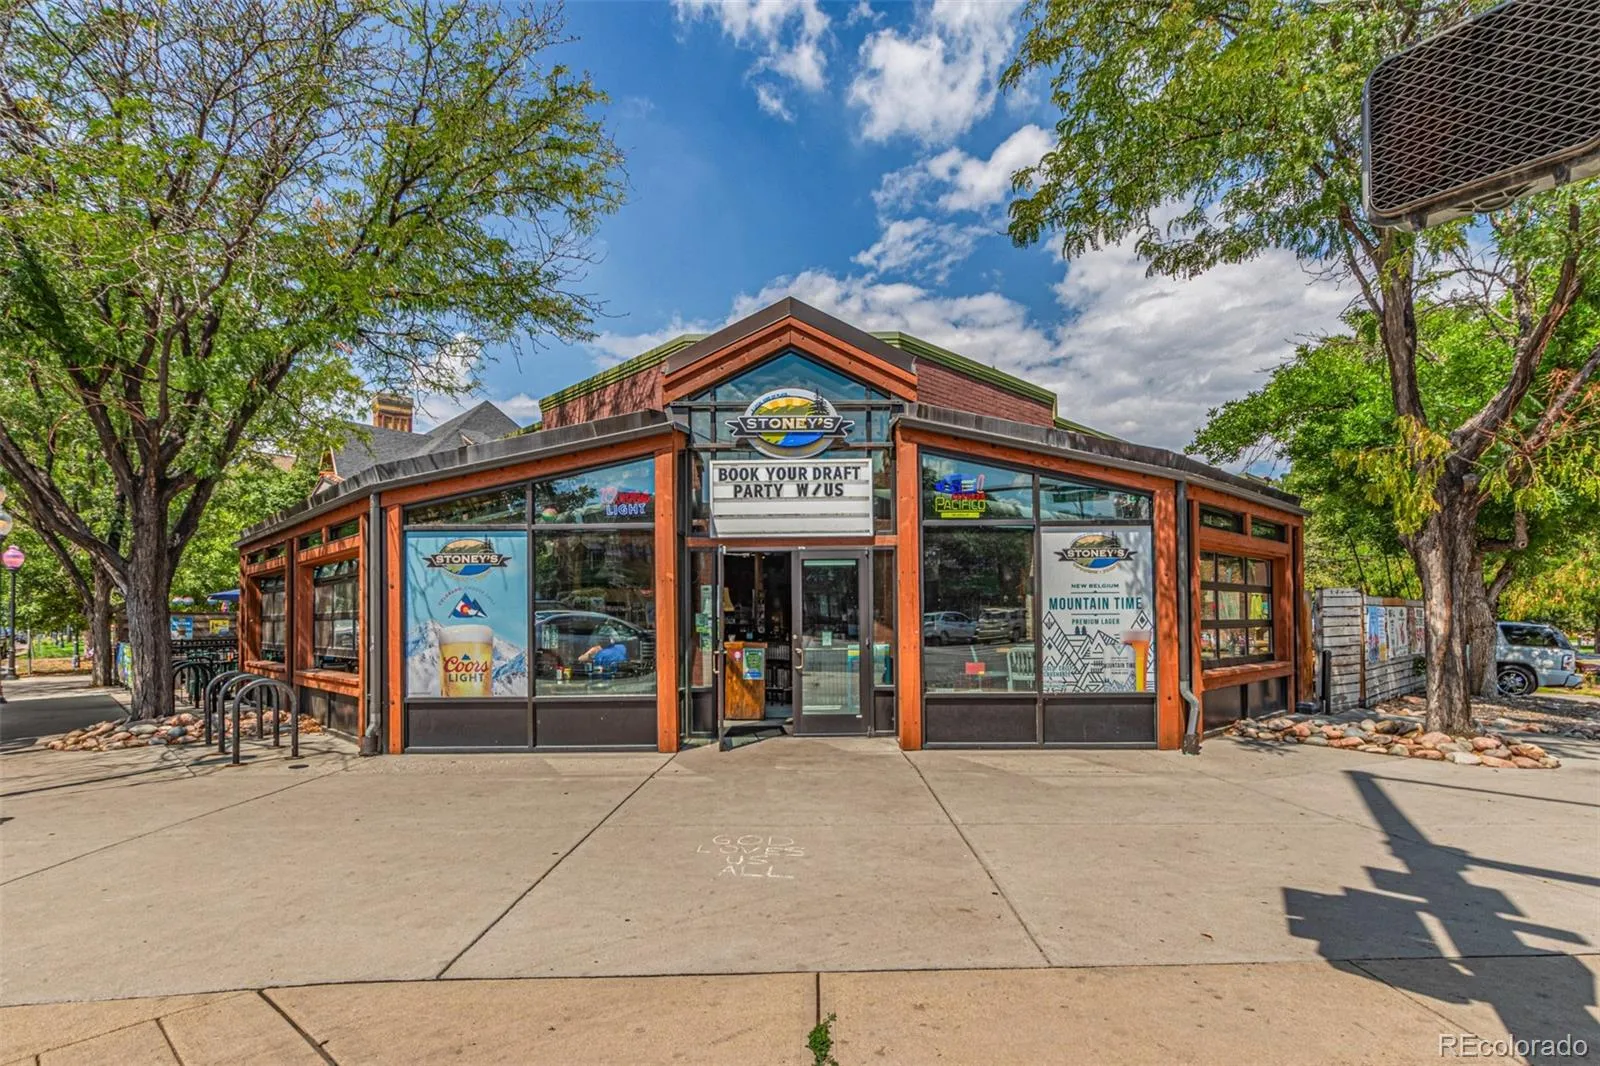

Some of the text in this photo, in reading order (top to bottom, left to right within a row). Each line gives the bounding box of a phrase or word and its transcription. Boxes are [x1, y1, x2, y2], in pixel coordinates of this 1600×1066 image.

[747, 417, 834, 430] STONEY'S
[718, 466, 861, 482] BOOK YOUR DRAFT
[733, 483, 783, 498] PARTY
[605, 502, 646, 516] LIGHT
[435, 555, 499, 564] STONEY'S
[1067, 549, 1125, 558] STONEY'S
[1049, 597, 1142, 610] MOUNTAIN TIME
[443, 655, 489, 673] Coors
[448, 673, 485, 682] LIGHT
[712, 835, 794, 846] GOD
[696, 844, 805, 858] LOVES
[726, 855, 769, 865] US
[718, 865, 795, 879] ALL
